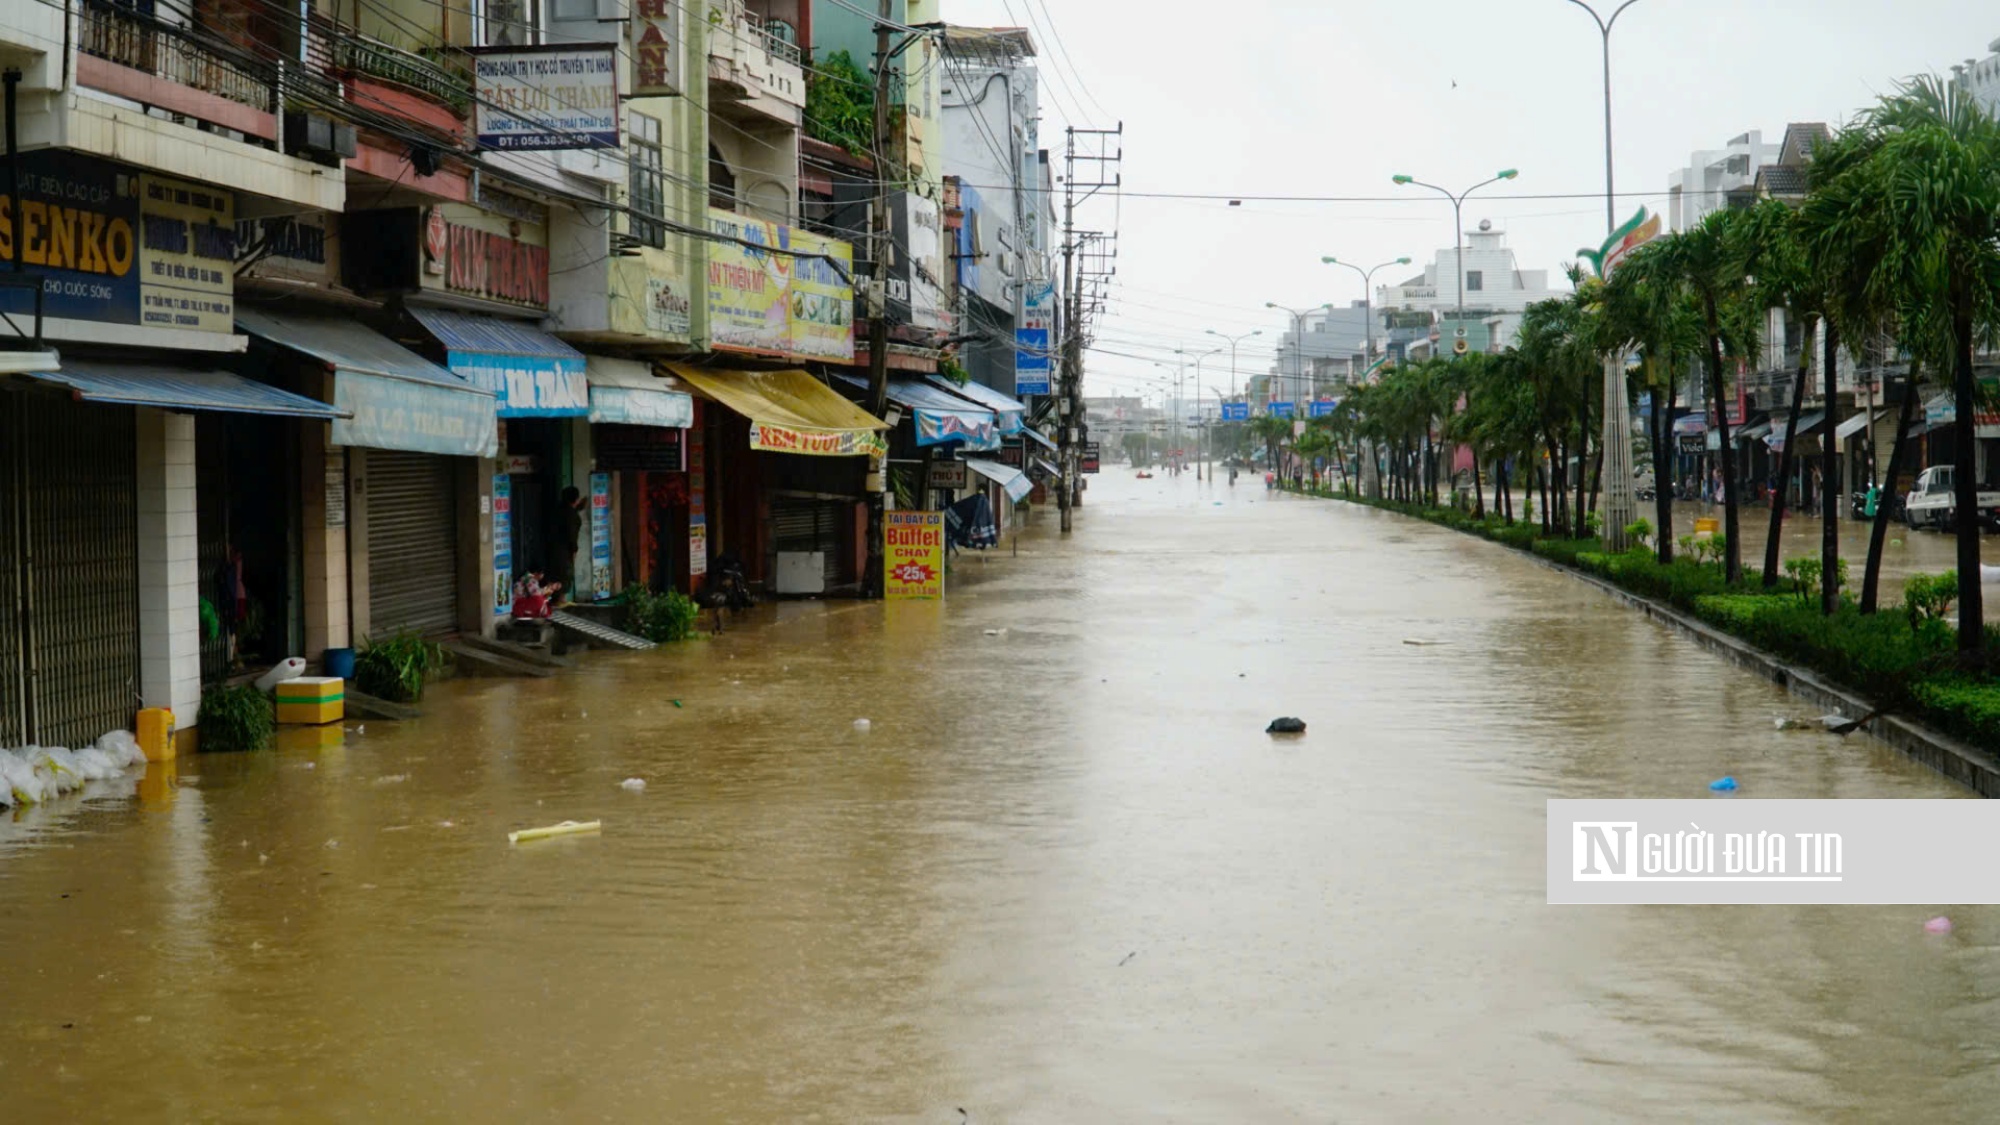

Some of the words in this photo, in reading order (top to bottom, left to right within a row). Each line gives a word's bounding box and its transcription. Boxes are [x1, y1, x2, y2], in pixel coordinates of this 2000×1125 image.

[0, 194, 133, 277] SENKO
[43, 279, 62, 293] CHO
[759, 425, 797, 449] KEM
[894, 548, 931, 558] CHAY
